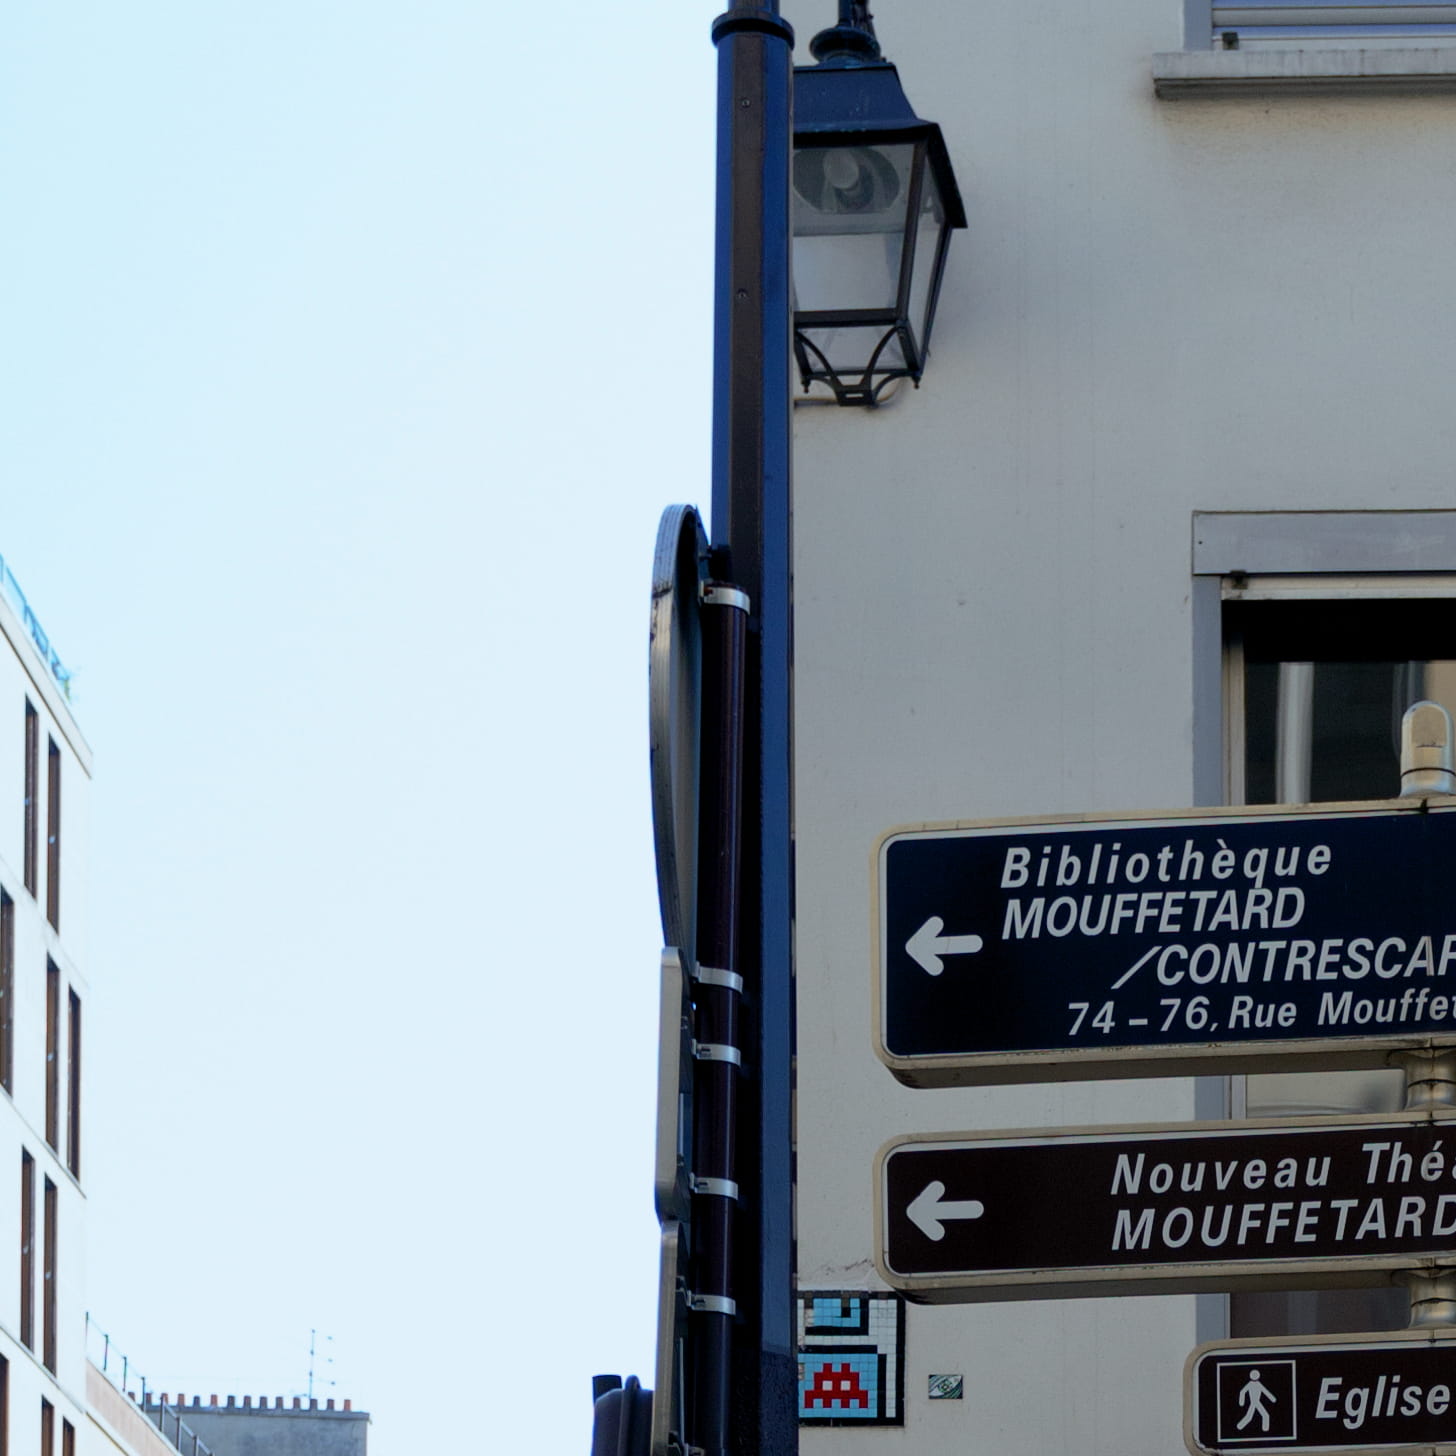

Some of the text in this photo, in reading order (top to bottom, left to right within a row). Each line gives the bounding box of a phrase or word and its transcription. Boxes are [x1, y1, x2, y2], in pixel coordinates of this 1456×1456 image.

[1000, 838, 1332, 889] Bibliothèque
[1001, 886, 1305, 940] MOUFFETARD
[1228, 995, 1297, 1029] Rue
[1110, 1153, 1331, 1195] Nouveau
[1315, 1374, 1451, 1430] Eglise
